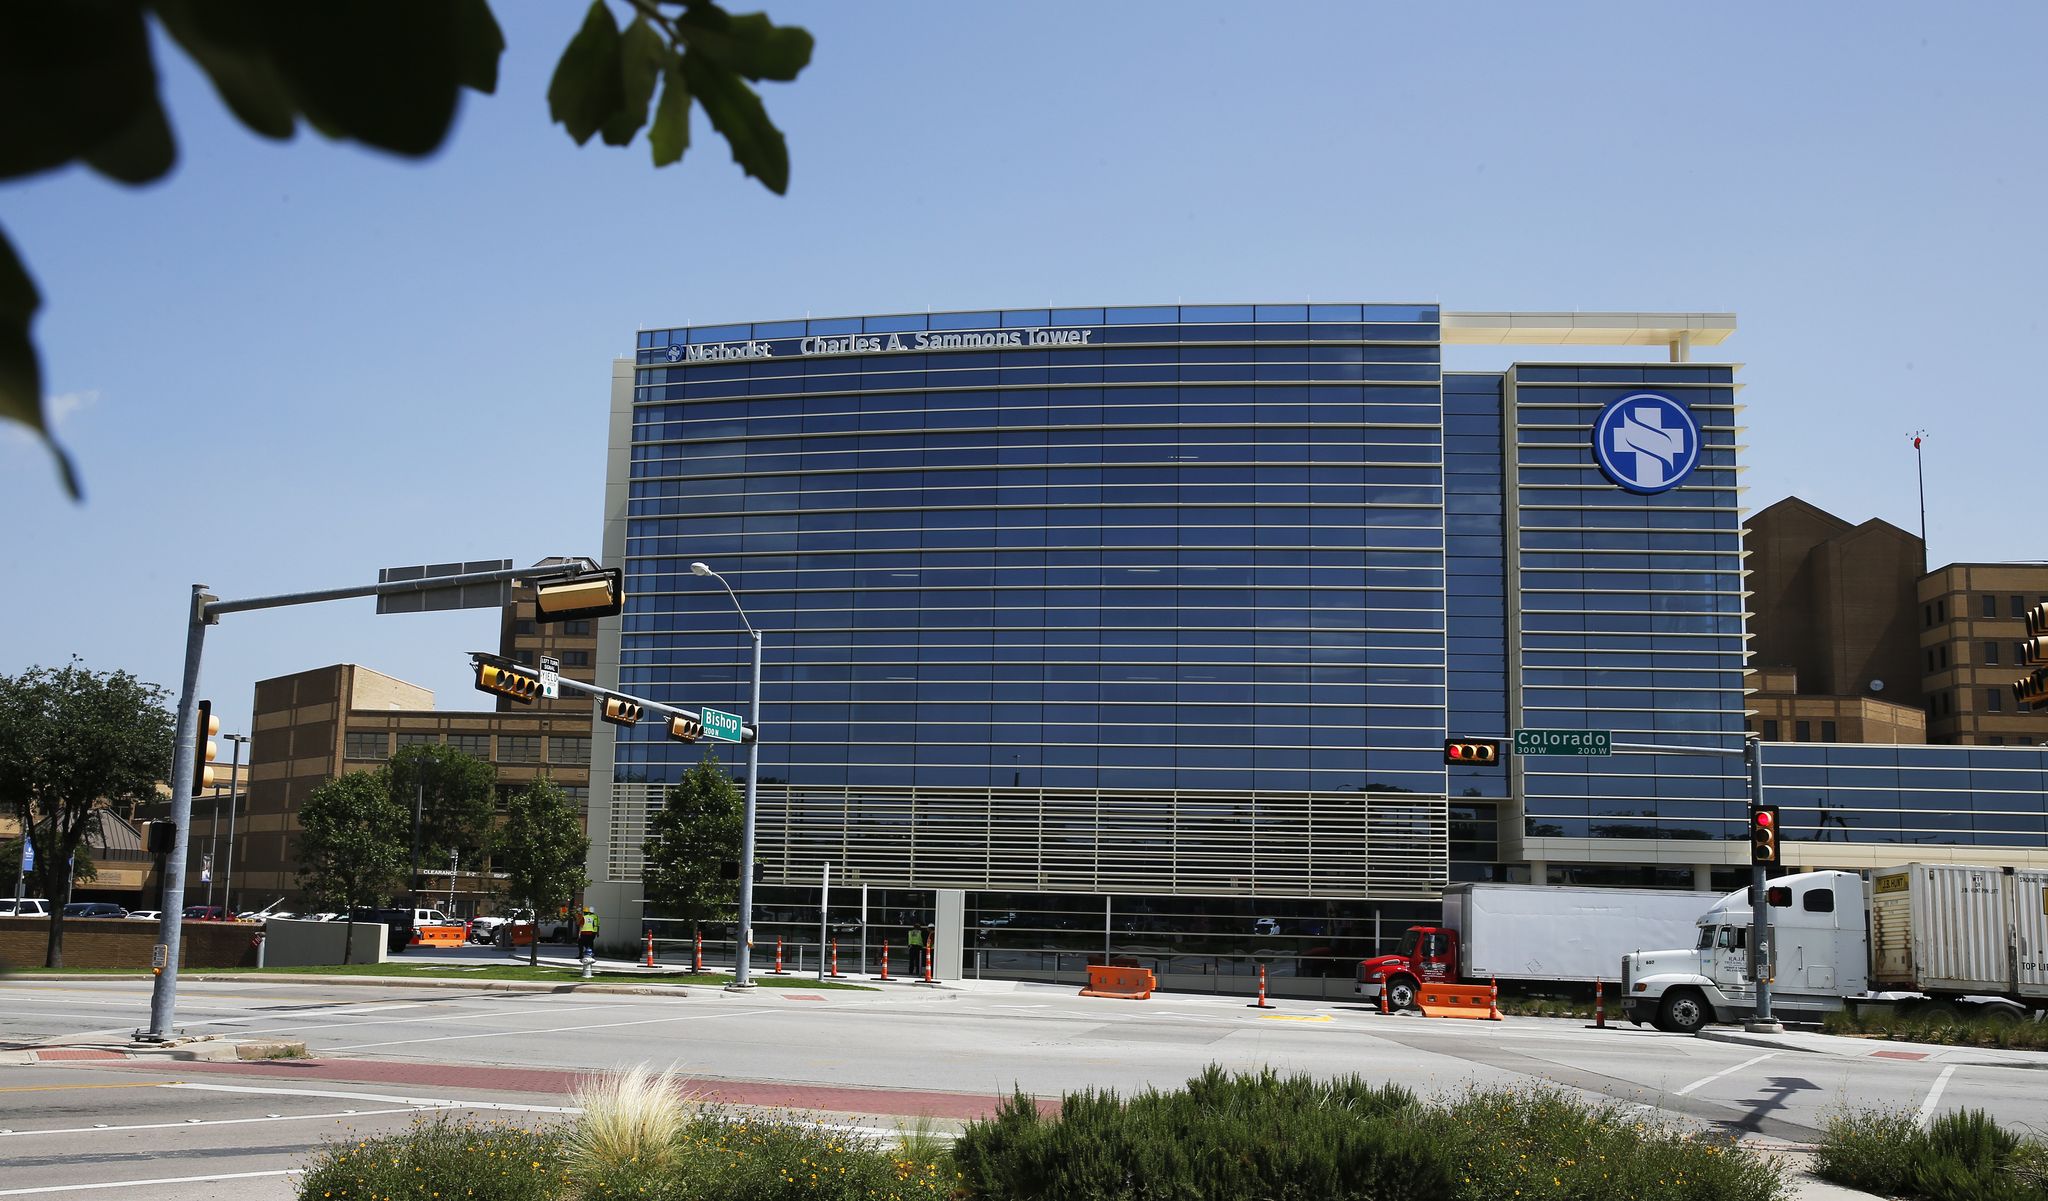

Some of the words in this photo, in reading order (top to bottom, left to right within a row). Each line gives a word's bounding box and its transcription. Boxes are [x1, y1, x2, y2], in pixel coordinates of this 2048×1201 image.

[685, 340, 773, 362] Methodist
[800, 333, 880, 356] Charles
[886, 333, 908, 351] A.
[914, 330, 1023, 350] Sammons
[1025, 327, 1092, 346] Tower
[541, 671, 558, 683] YIELD
[706, 711, 738, 734] Bishop
[1518, 731, 1606, 746] Colorado
[1517, 746, 1536, 754] 300
[1577, 747, 1597, 755] 200
[1598, 747, 1607, 755] W
[2022, 962, 2036, 971] TOP
